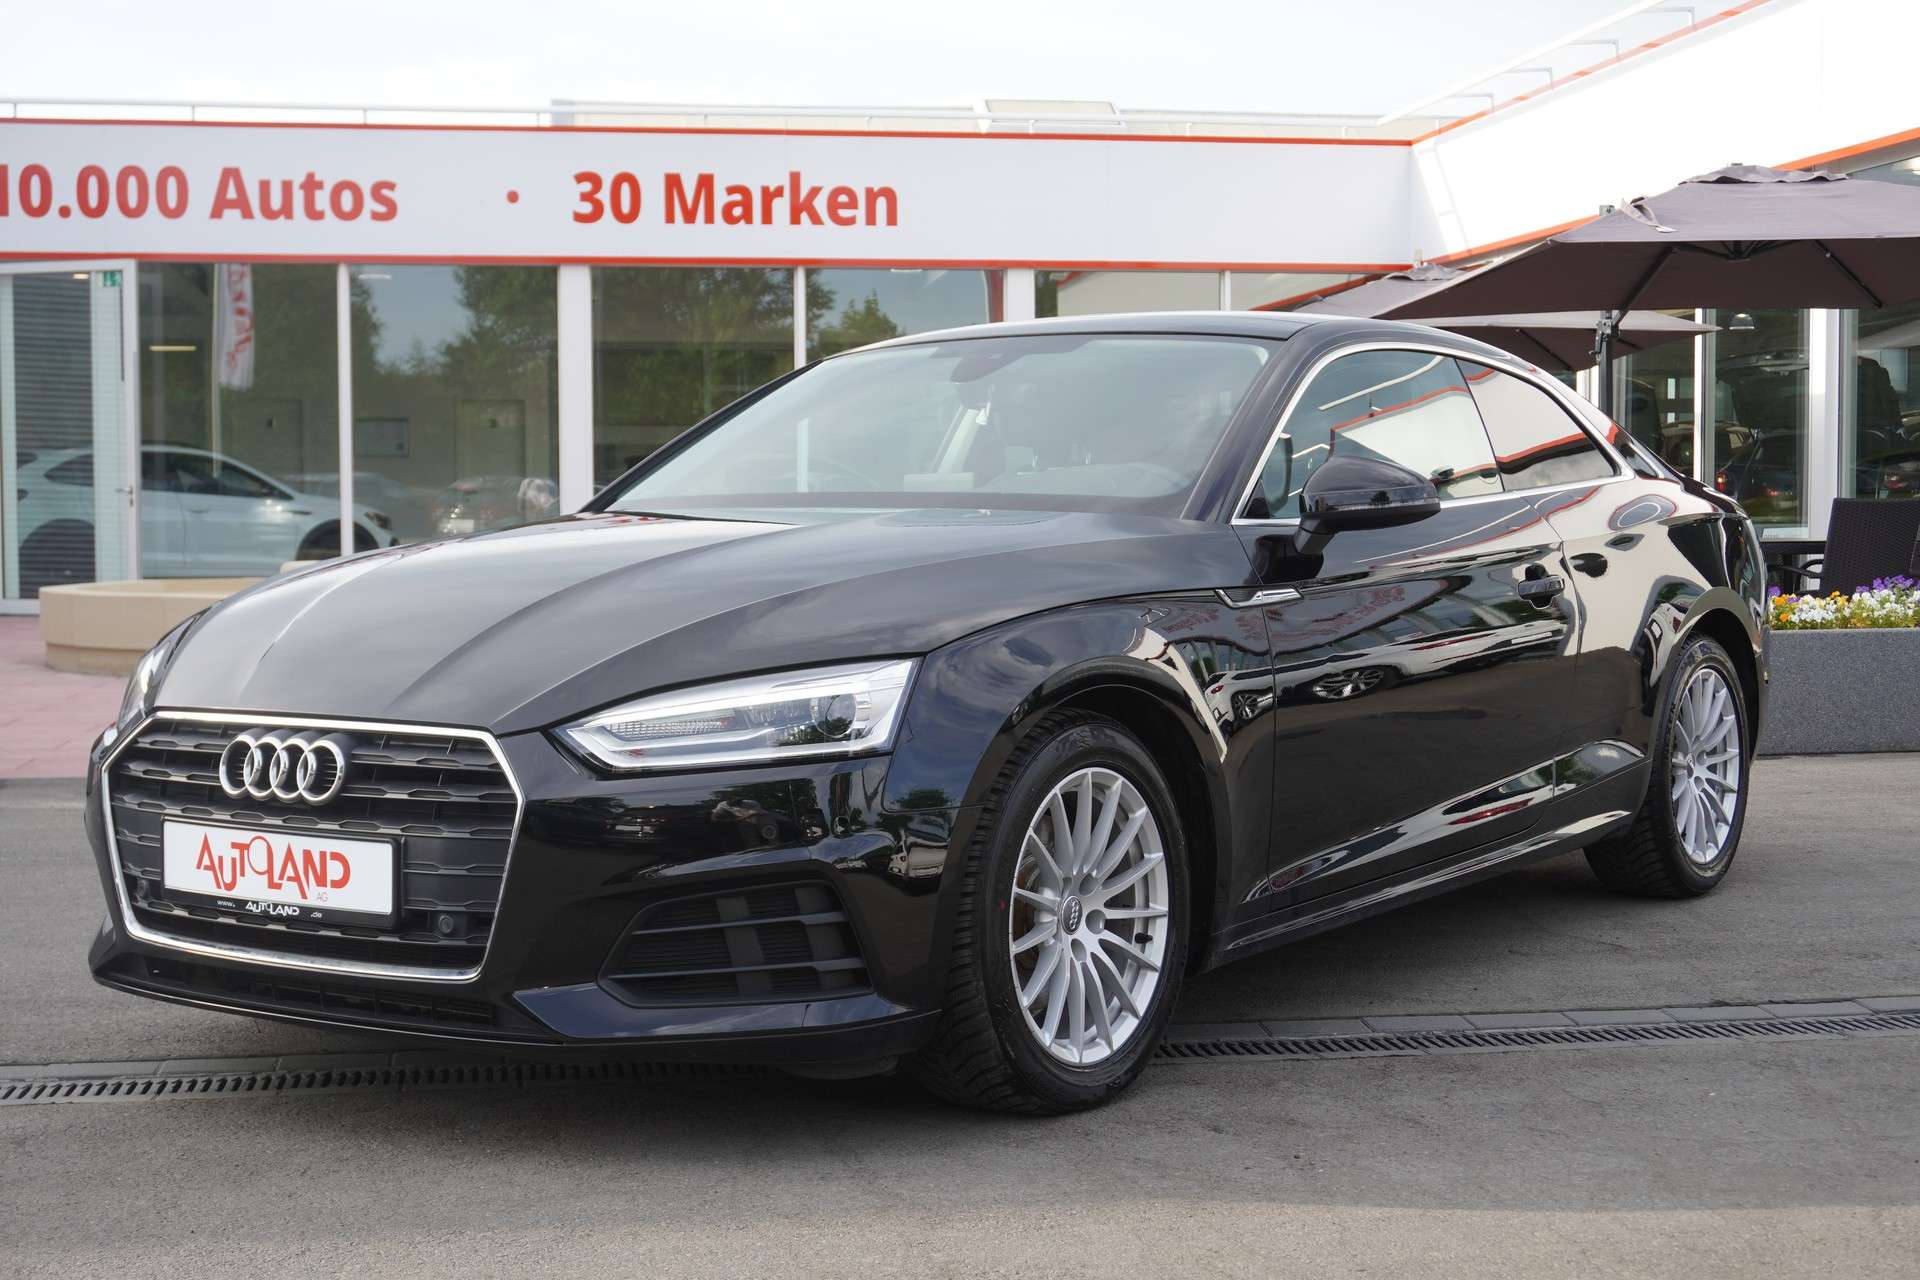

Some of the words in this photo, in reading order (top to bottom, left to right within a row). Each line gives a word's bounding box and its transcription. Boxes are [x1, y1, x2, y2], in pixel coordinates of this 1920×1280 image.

[209, 167, 398, 222] Autos
[573, 170, 642, 225] 30
[664, 171, 898, 228] Marken
[196, 832, 351, 900] AUTOLAND
